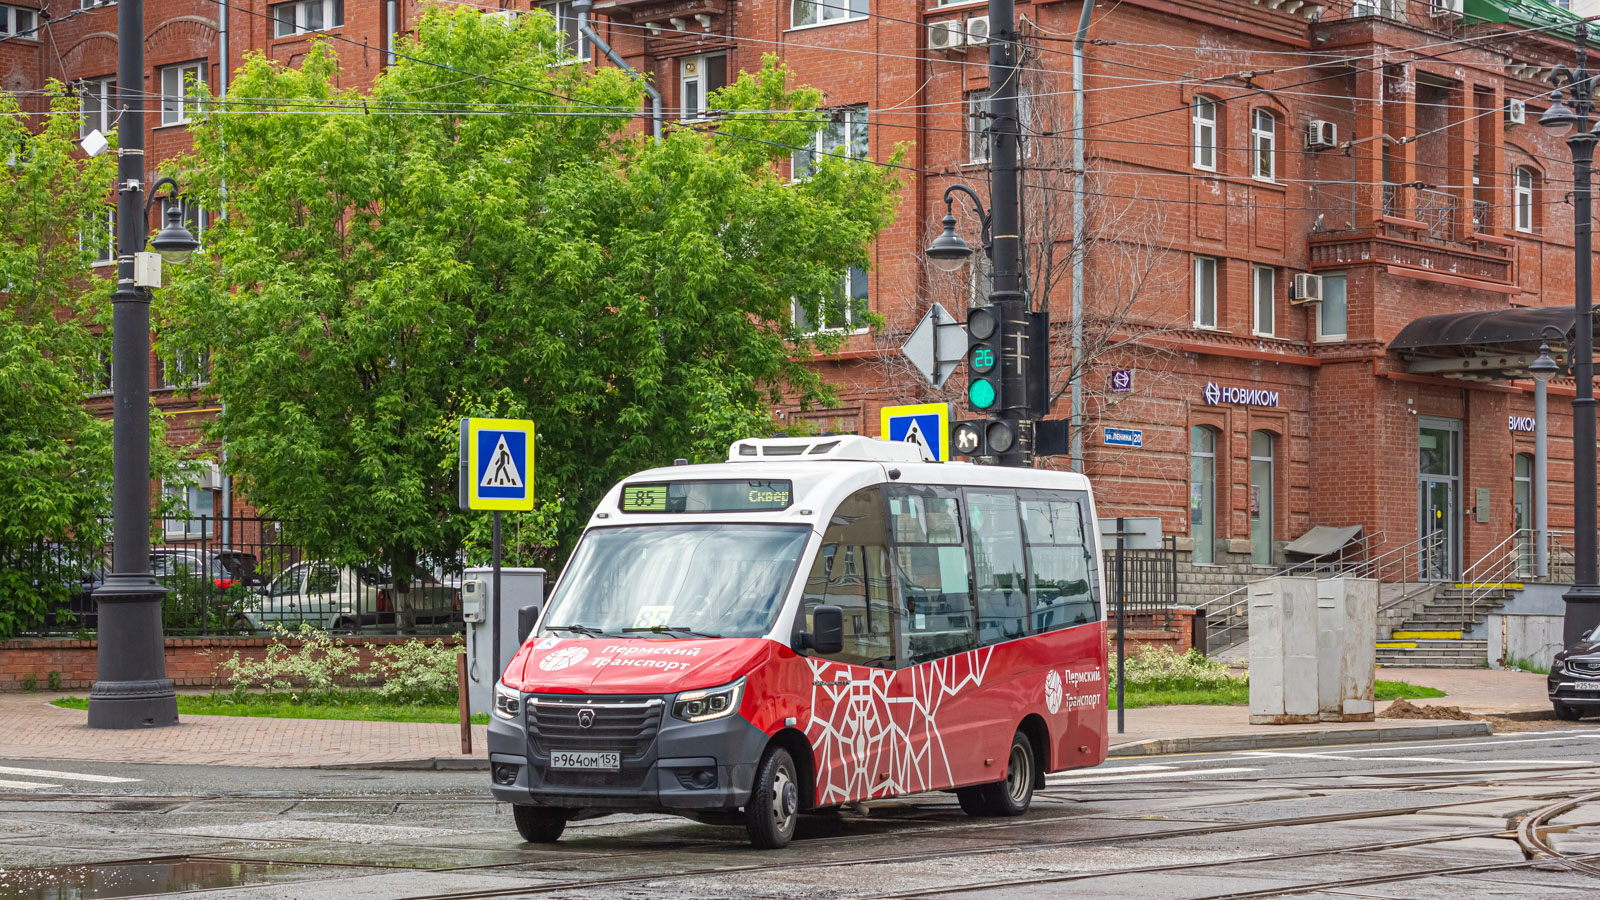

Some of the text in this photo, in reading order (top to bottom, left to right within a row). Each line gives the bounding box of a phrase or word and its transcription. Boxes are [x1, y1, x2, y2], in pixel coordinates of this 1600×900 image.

[975, 349, 994, 367] 26
[1222, 386, 1279, 407] НОВИКОМ
[1133, 433, 1141, 443] 20
[635, 490, 654, 507] 85
[748, 490, 789, 506] Сквер
[636, 609, 668, 628] 85
[602, 645, 701, 657] Пермский
[591, 657, 691, 671] Транспорт
[1065, 666, 1101, 688] Пермский
[1065, 693, 1101, 712] Транспорт
[600, 753, 617, 765] 159
